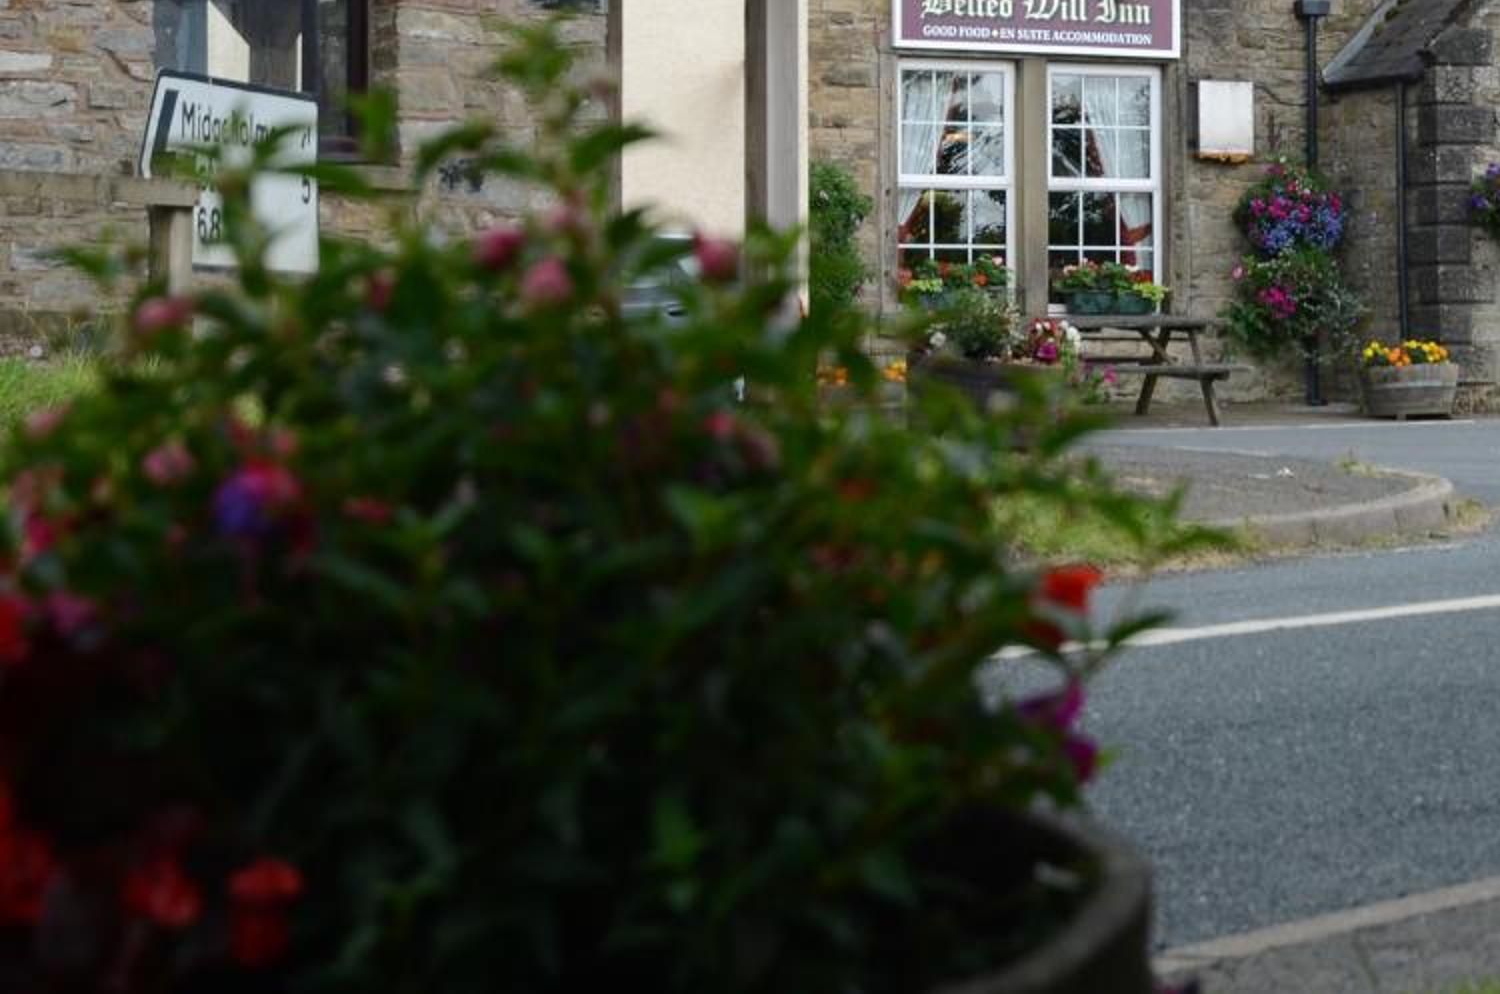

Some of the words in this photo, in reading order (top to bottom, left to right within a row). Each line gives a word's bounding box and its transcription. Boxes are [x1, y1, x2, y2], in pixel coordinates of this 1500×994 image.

[923, 24, 957, 37] GOOD
[959, 26, 990, 38] FOOD
[999, 27, 1015, 39] EN
[1017, 29, 1050, 41] SUITE
[1053, 31, 1152, 45] ACCOMMODATION
[182, 101, 275, 146] Midgeholm
